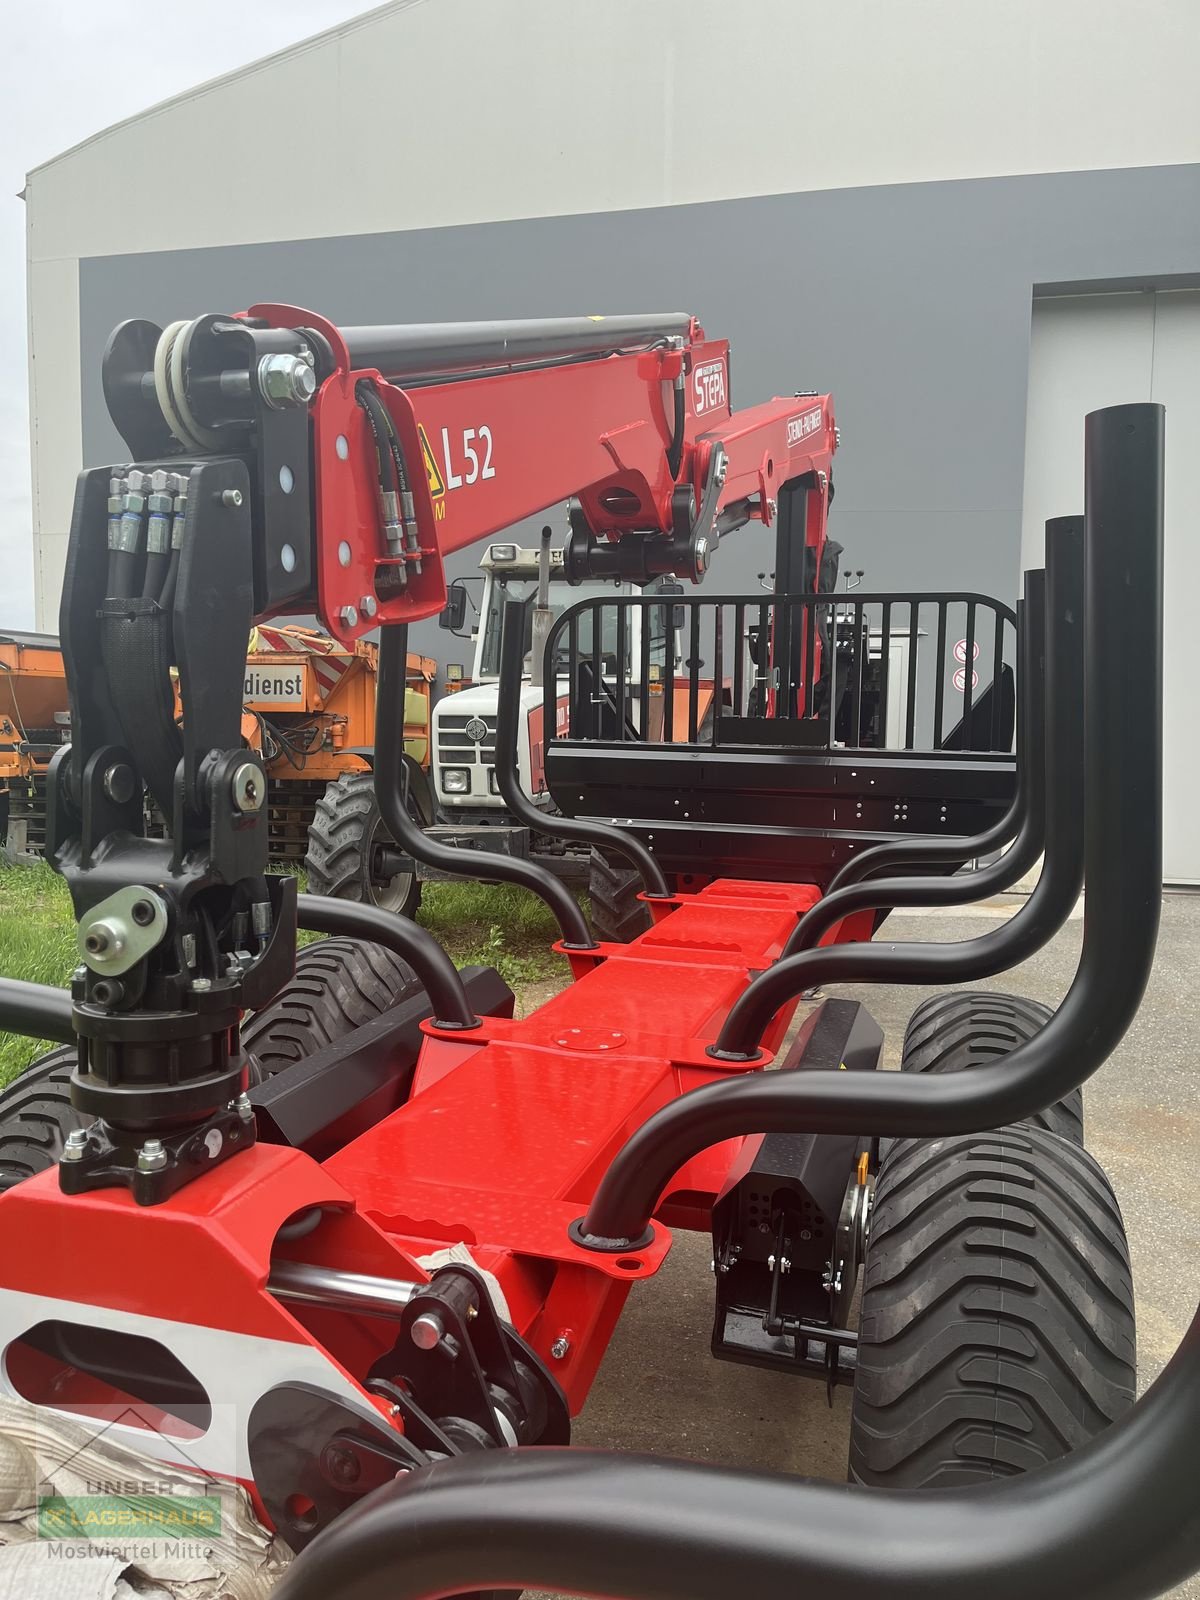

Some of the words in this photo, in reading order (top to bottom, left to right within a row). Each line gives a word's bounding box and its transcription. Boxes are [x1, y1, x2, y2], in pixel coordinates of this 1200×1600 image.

[695, 367, 725, 413] STEPA
[441, 425, 496, 490] L52
[244, 673, 302, 696] dienst
